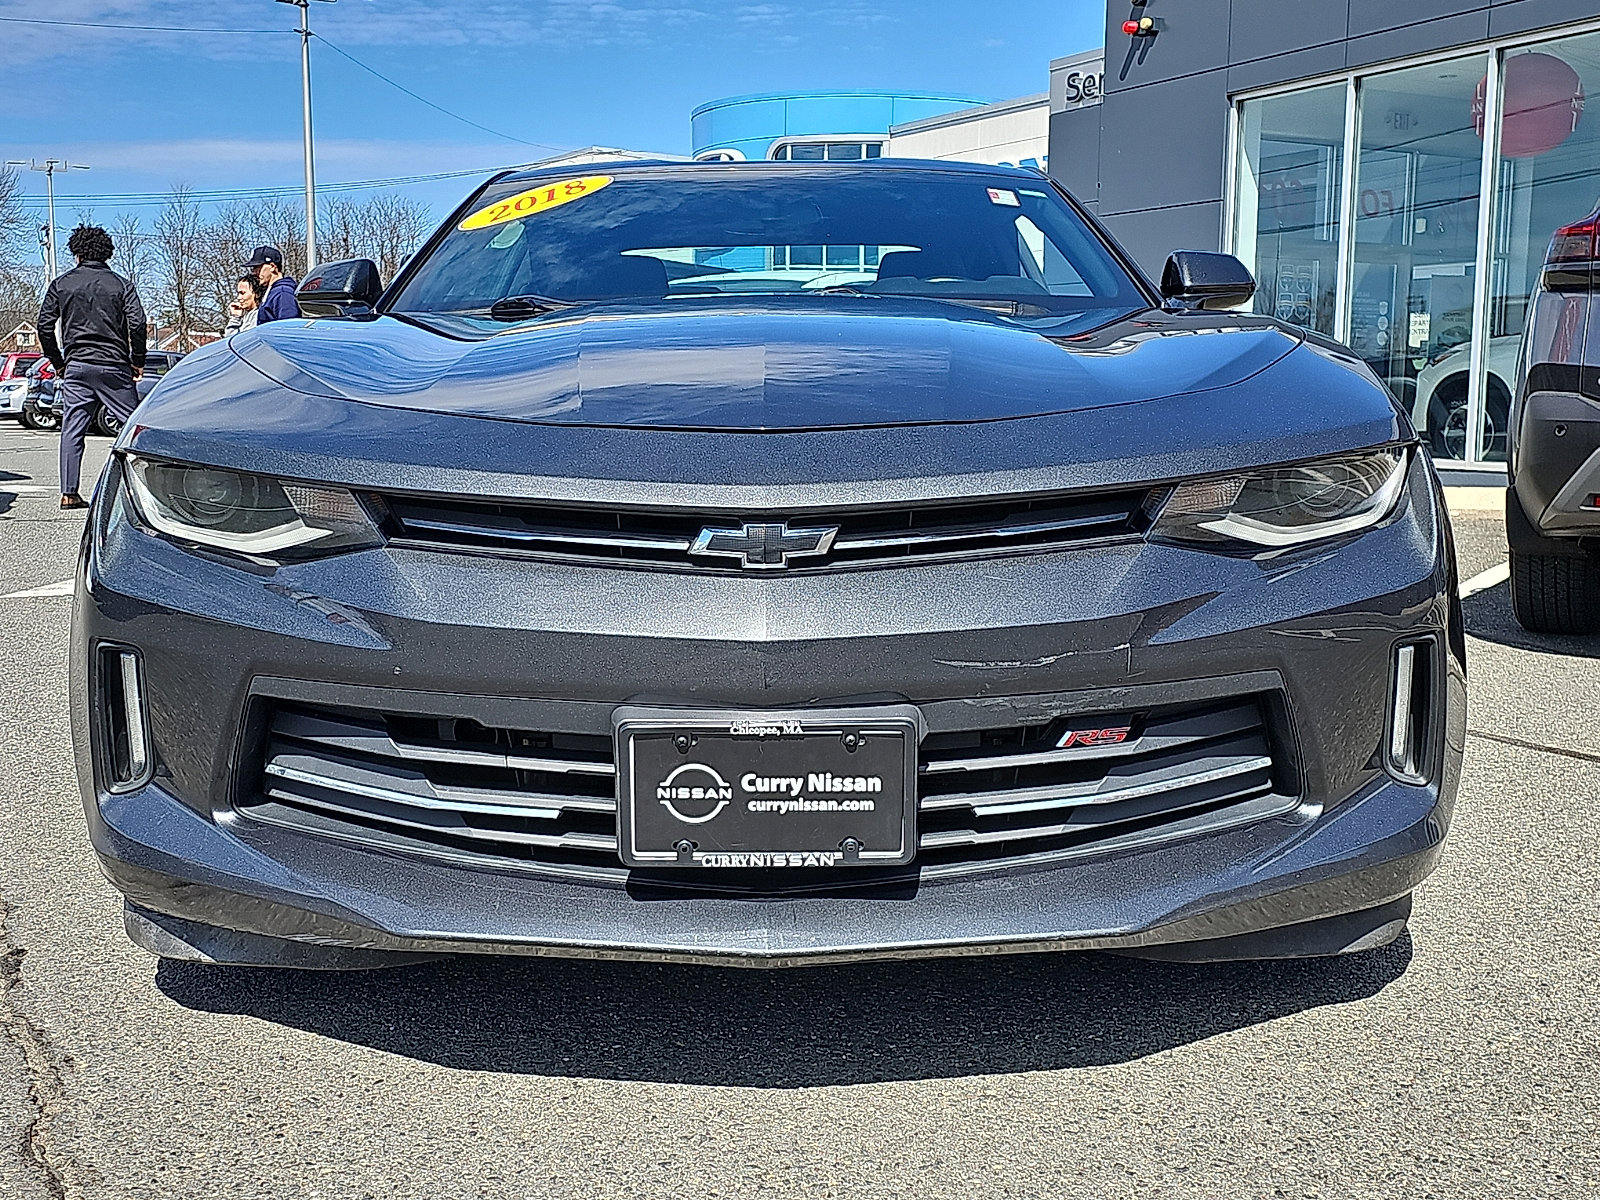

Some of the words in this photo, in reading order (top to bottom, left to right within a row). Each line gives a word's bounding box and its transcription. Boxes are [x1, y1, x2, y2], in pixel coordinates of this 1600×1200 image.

[489, 180, 587, 223] 2018
[781, 723, 804, 735] MA
[1056, 726, 1131, 747] RS
[656, 787, 733, 800] NISSAN
[741, 773, 804, 796] Curry
[808, 772, 882, 793] Nissan
[747, 797, 875, 814] currynissan.com
